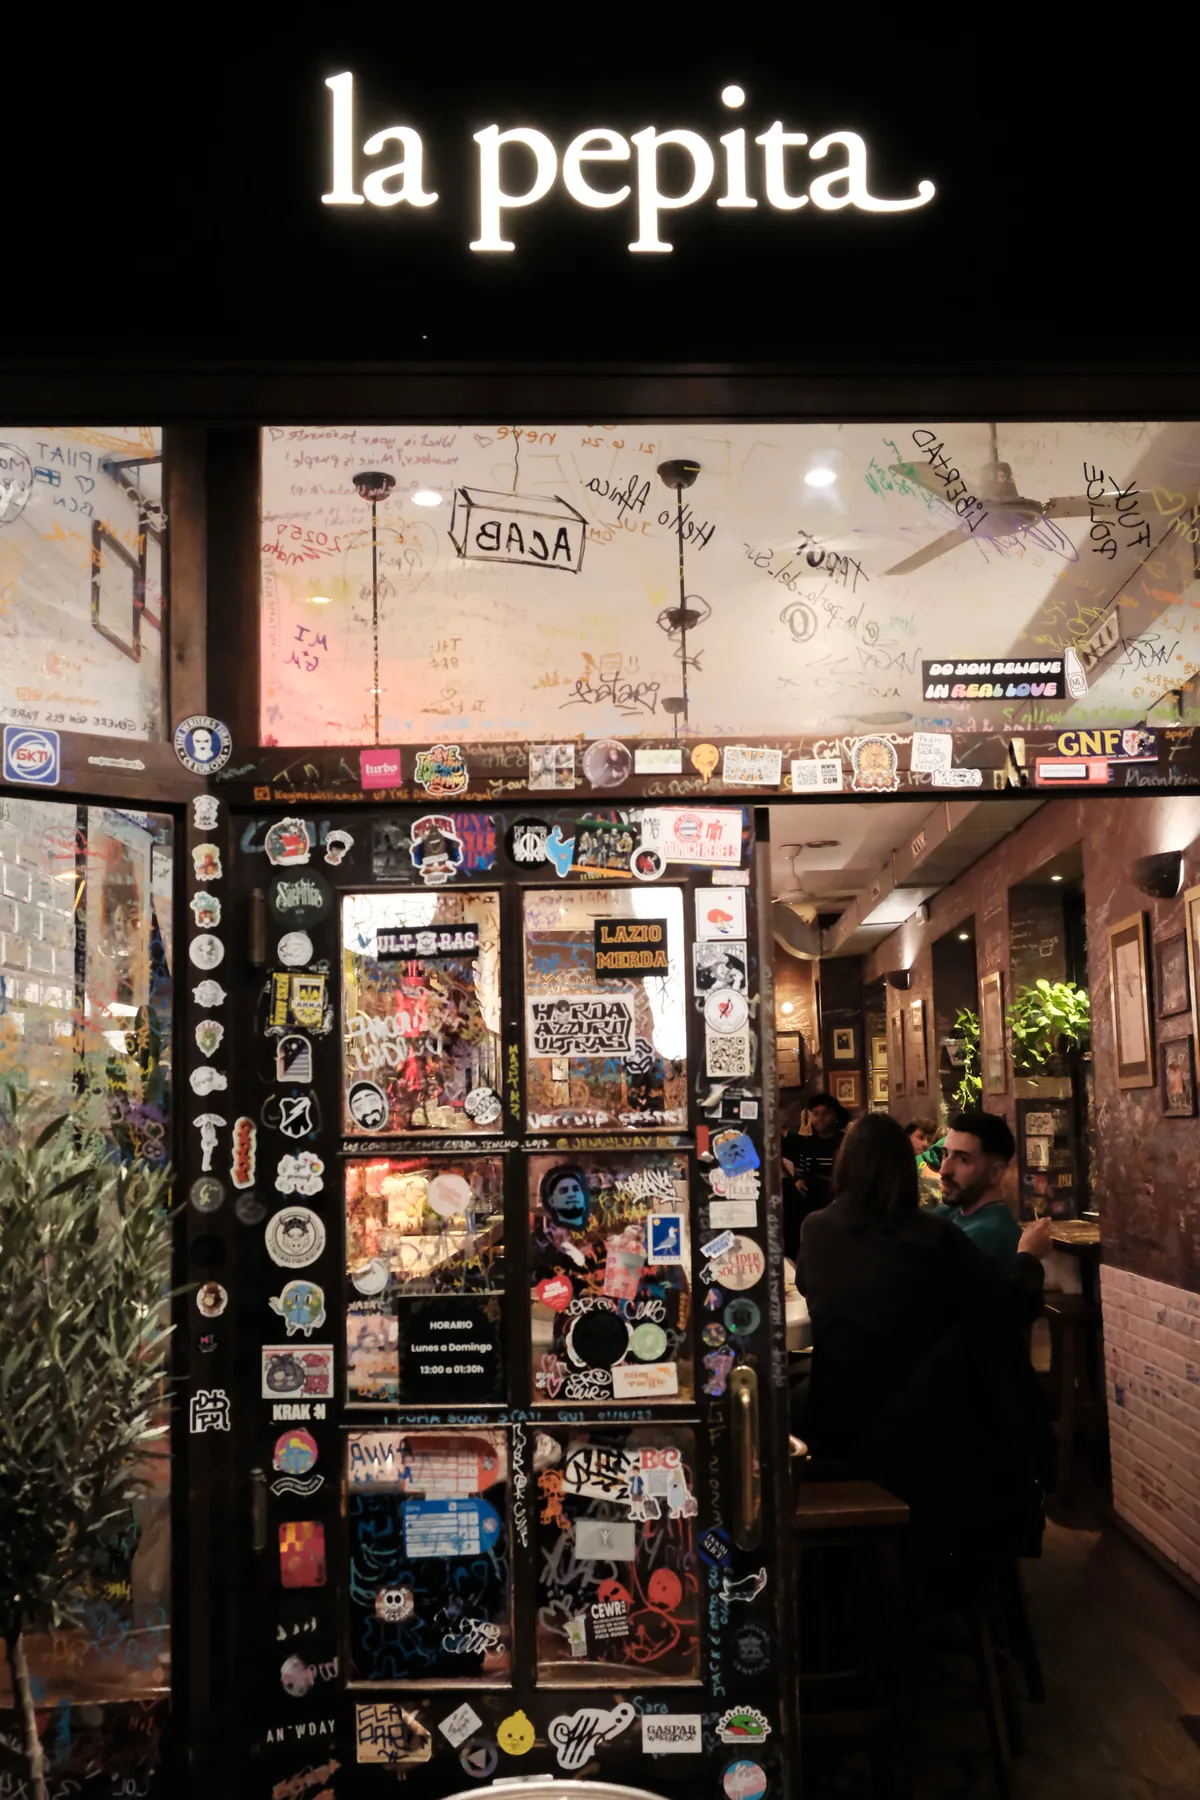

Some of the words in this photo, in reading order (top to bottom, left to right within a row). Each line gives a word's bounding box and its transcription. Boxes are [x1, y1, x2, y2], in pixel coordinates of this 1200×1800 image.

[321, 71, 439, 207] la
[469, 84, 936, 252] pepita
[929, 663, 953, 676] DO
[992, 661, 1062, 675] BELIEVE
[925, 684, 949, 699] IN
[951, 683, 1004, 698] REAL
[1006, 682, 1058, 697] LOVE
[1057, 729, 1121, 757] GNF
[365, 761, 398, 775] turbo
[601, 925, 663, 943] LAZIO
[596, 951, 669, 969] MERDA
[728, 1252, 761, 1265] CIDER
[430, 1320, 473, 1331] HORARIO
[411, 1342, 439, 1353] Lunes
[440, 1344, 447, 1352] a
[448, 1342, 492, 1354] Domingo
[420, 1365, 444, 1375] 13:00
[454, 1364, 484, 1375] 01:30h
[647, 1724, 696, 1736] GASPAR
